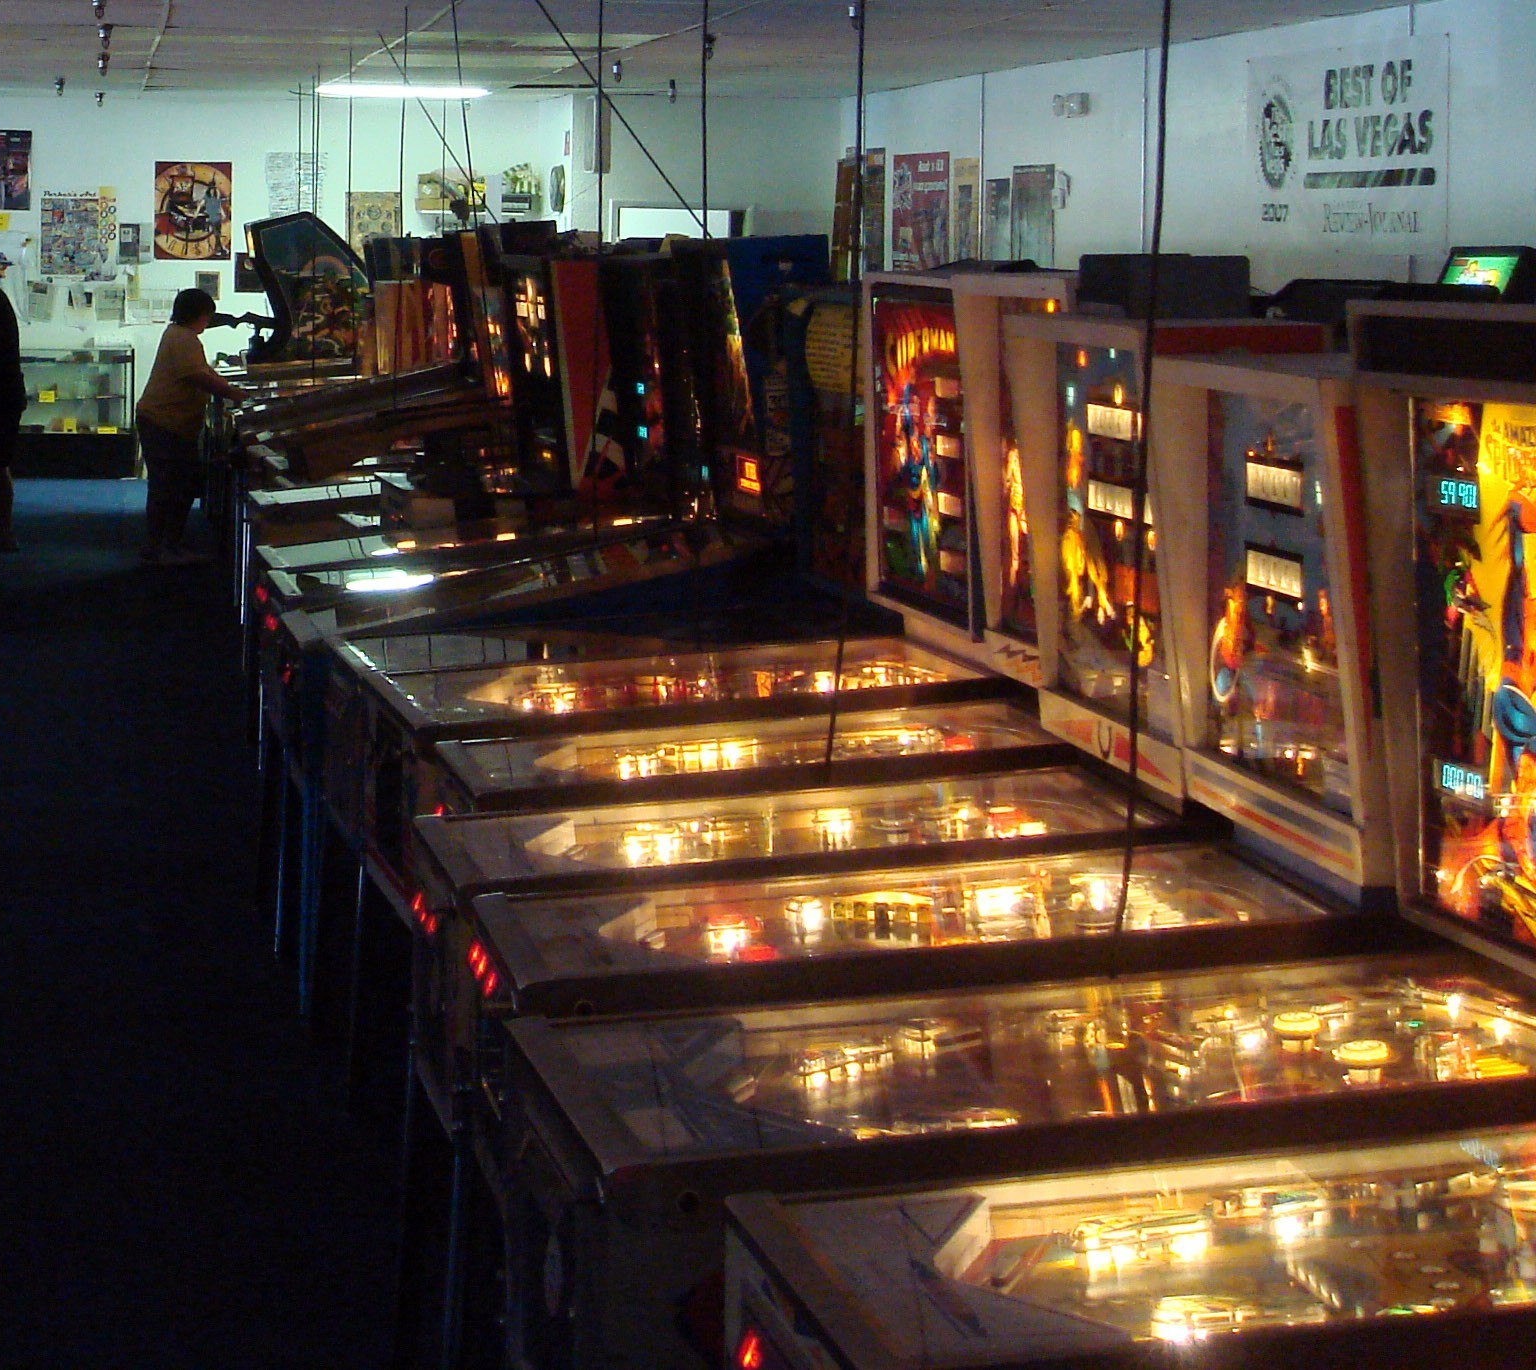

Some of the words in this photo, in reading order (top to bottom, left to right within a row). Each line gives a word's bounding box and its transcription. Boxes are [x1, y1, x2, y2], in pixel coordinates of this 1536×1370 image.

[1324, 65, 1375, 110] BEST
[1381, 59, 1413, 105] OF
[1308, 119, 1349, 160] LAS
[1353, 109, 1435, 158] VEGAS
[1261, 203, 1289, 222] 2007
